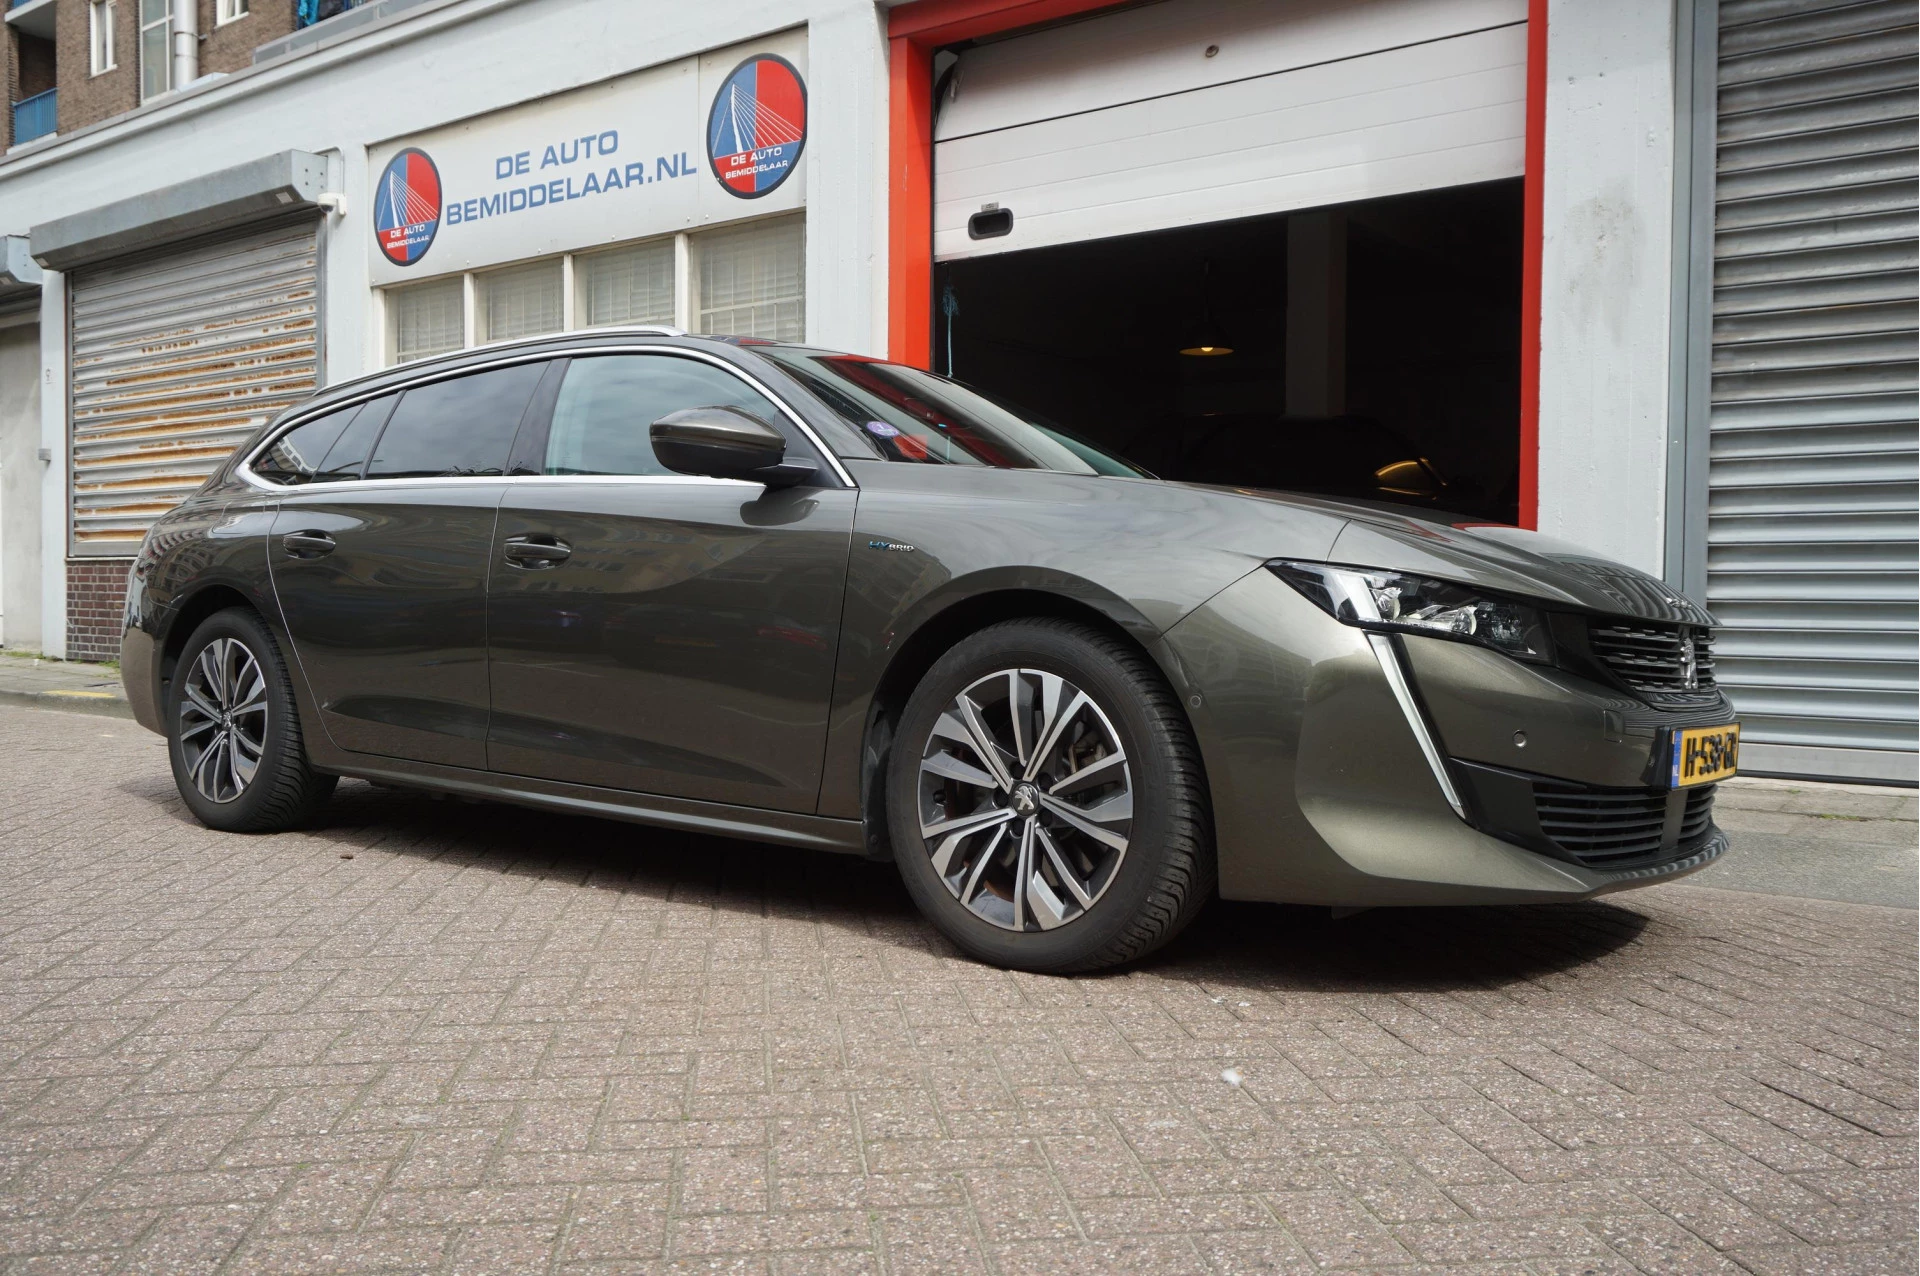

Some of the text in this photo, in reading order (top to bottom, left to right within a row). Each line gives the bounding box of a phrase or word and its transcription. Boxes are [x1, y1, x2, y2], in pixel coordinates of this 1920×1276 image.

[496, 130, 619, 180] DE AUTO
[731, 147, 782, 166] DE AUTO
[725, 160, 788, 179] BEMIDDELAAR
[446, 152, 698, 226] BEMIDDELAAR.NL
[390, 224, 425, 238] DE AUTO
[386, 235, 430, 249] BEMIDDELAAR
[869, 541, 915, 552] HYBRID
